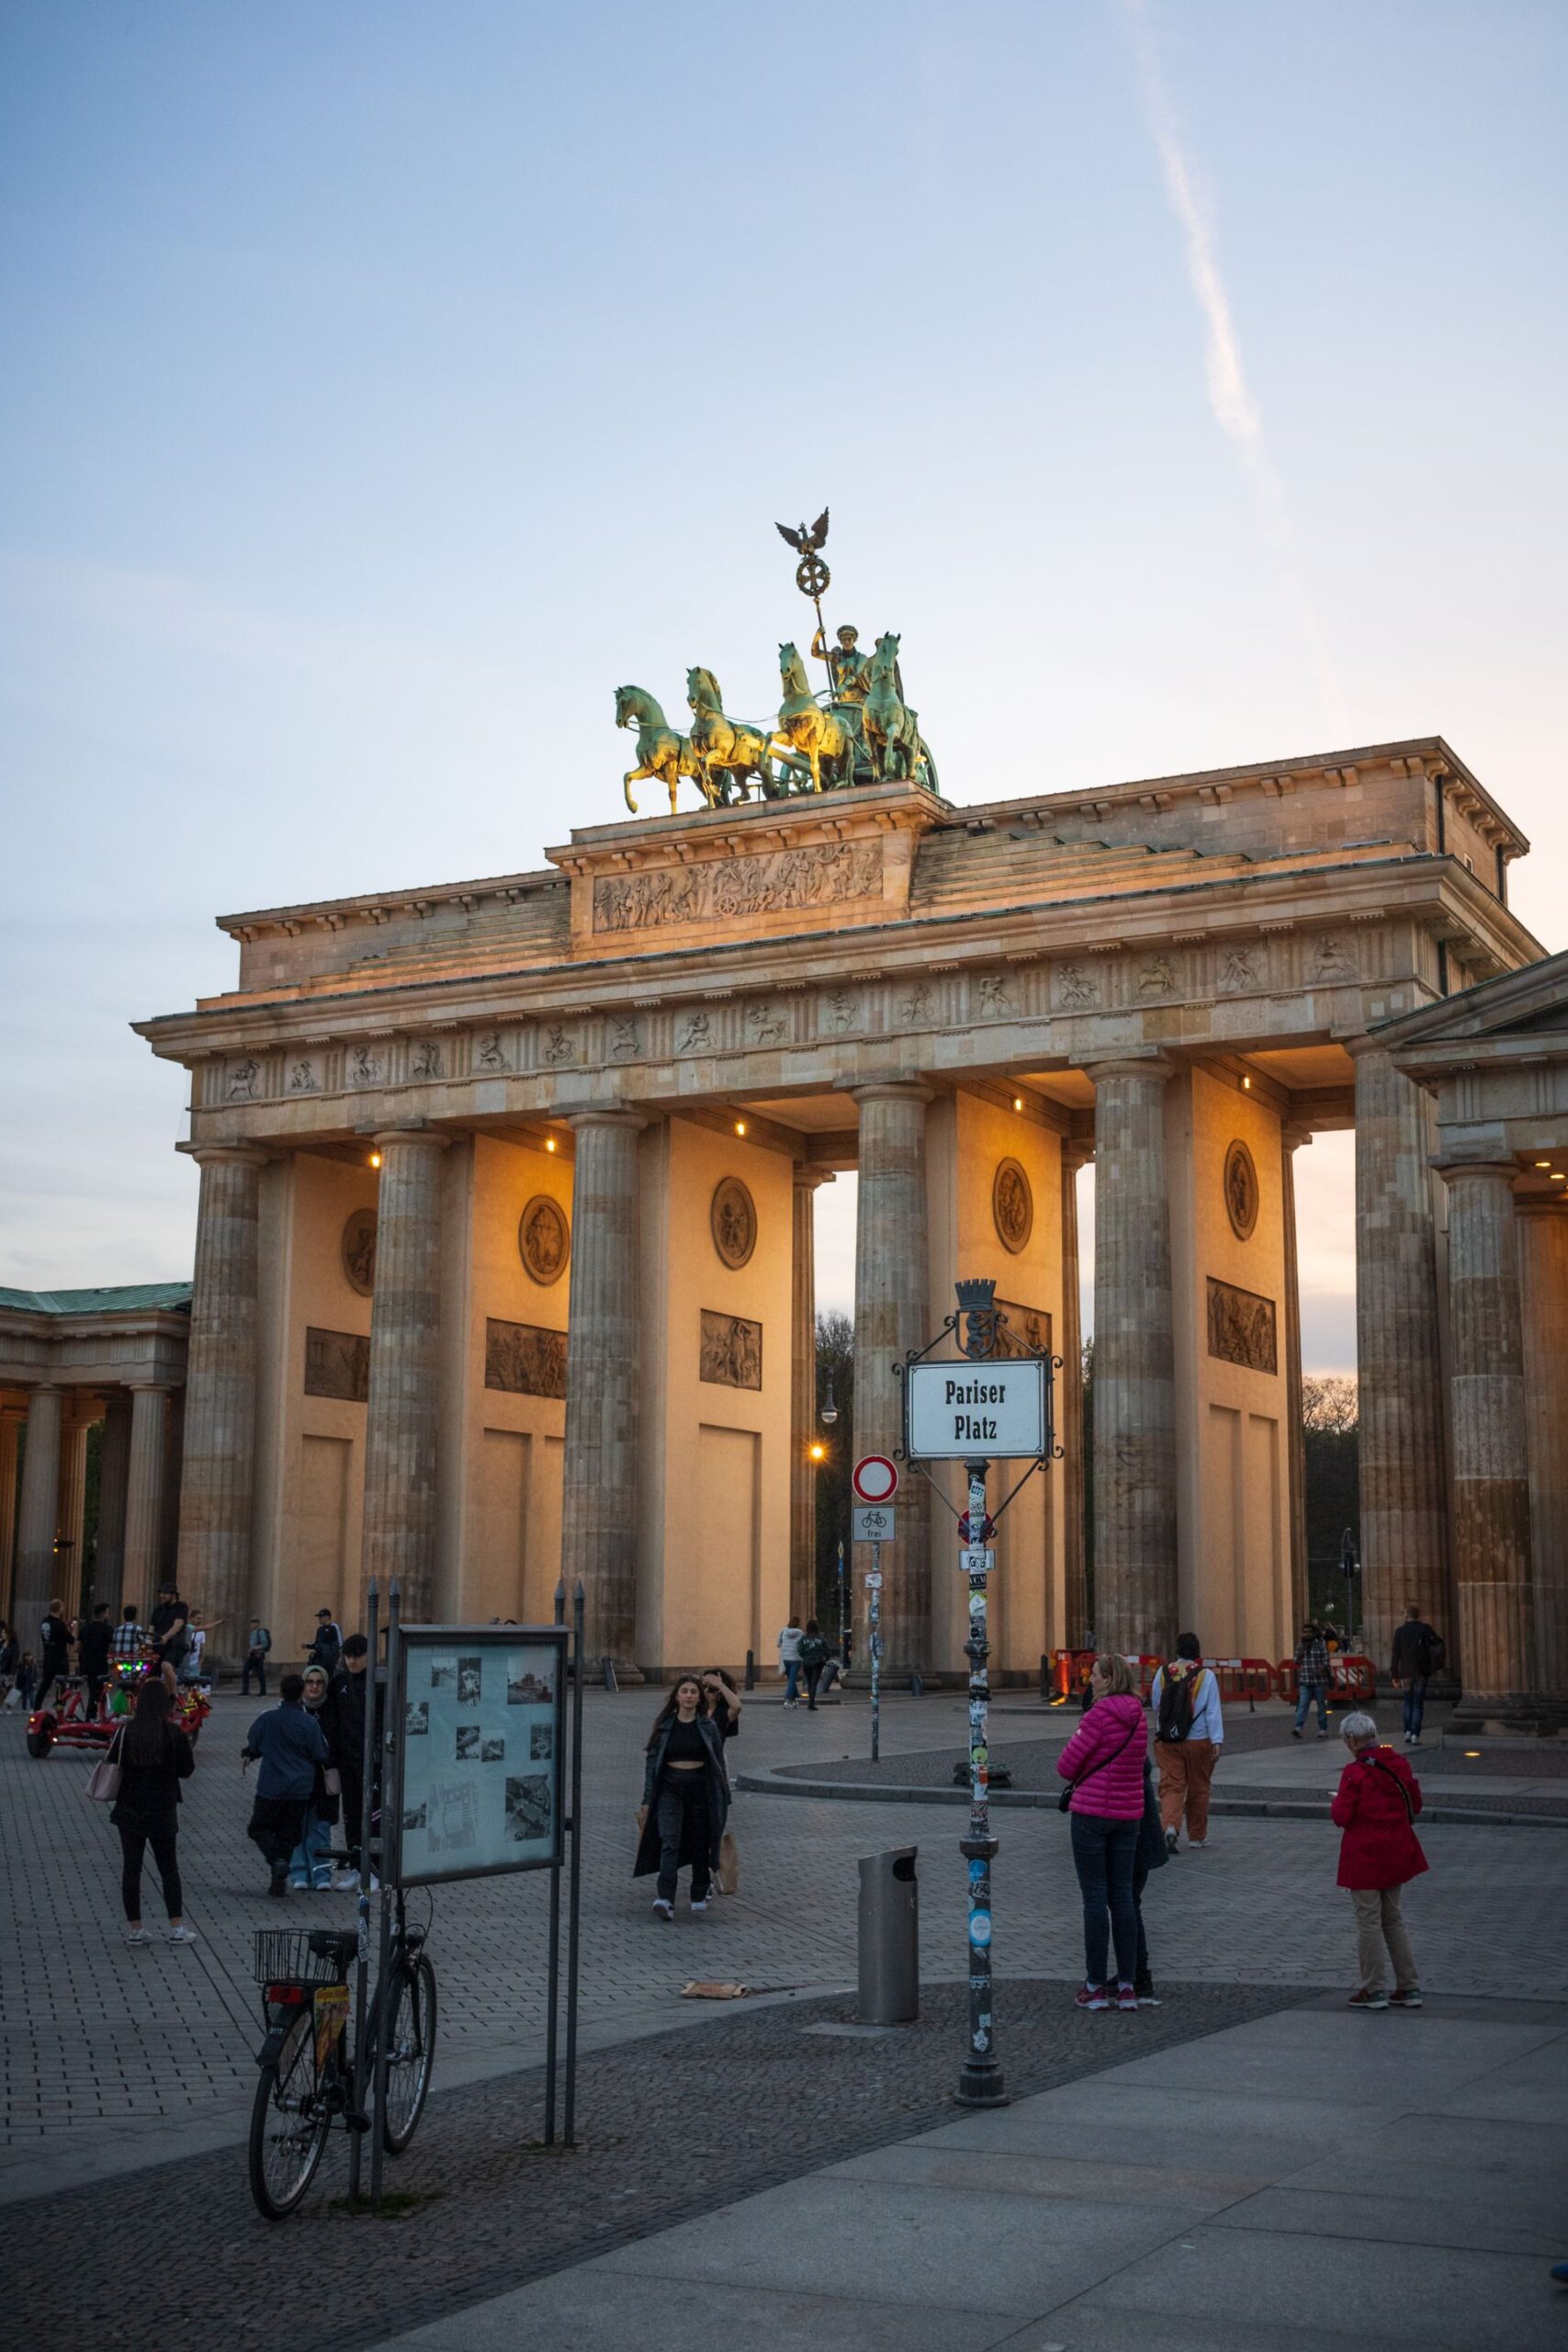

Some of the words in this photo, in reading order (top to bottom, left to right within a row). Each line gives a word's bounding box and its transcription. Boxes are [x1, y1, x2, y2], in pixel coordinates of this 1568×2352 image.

[945, 1379, 1006, 1405] Pariser
[954, 1415, 998, 1440] Platz
[867, 1529, 882, 1538] frei
